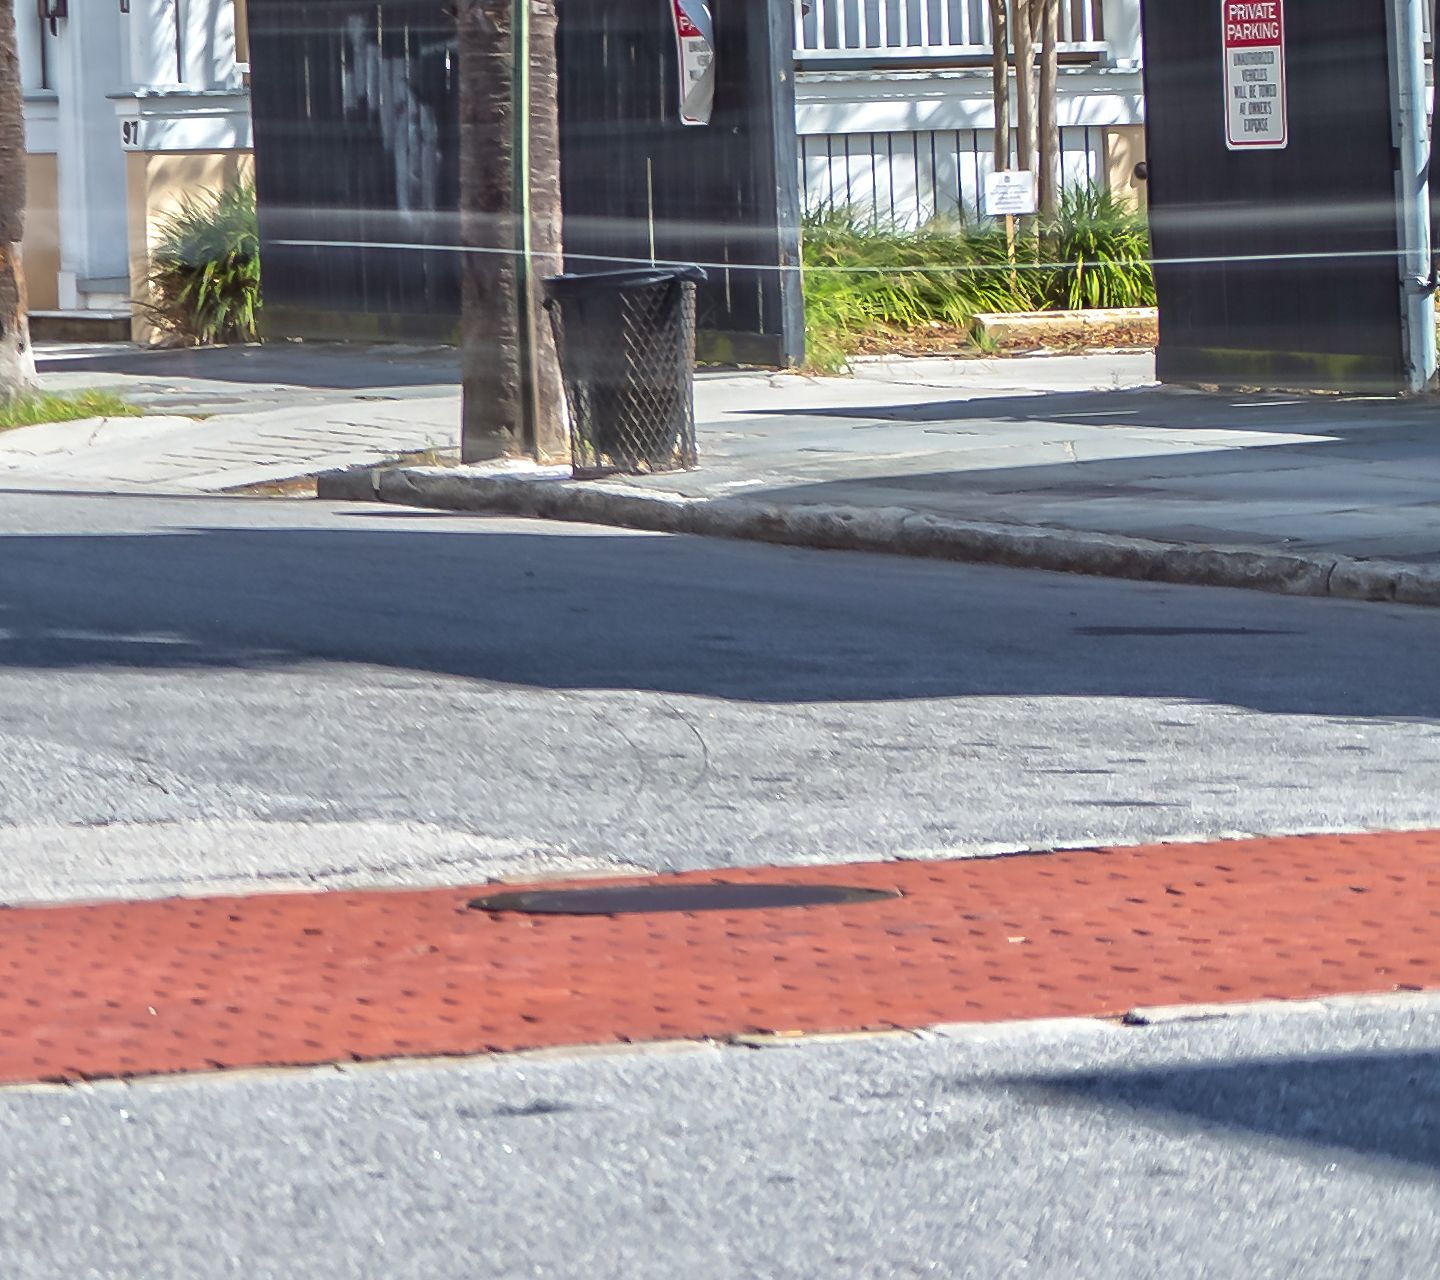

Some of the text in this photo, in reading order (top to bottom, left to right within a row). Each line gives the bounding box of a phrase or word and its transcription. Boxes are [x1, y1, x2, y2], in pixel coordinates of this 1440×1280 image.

[1228, 2, 1277, 20] PRIVATE
[1227, 22, 1279, 41] PARKING
[122, 120, 139, 145] 97
